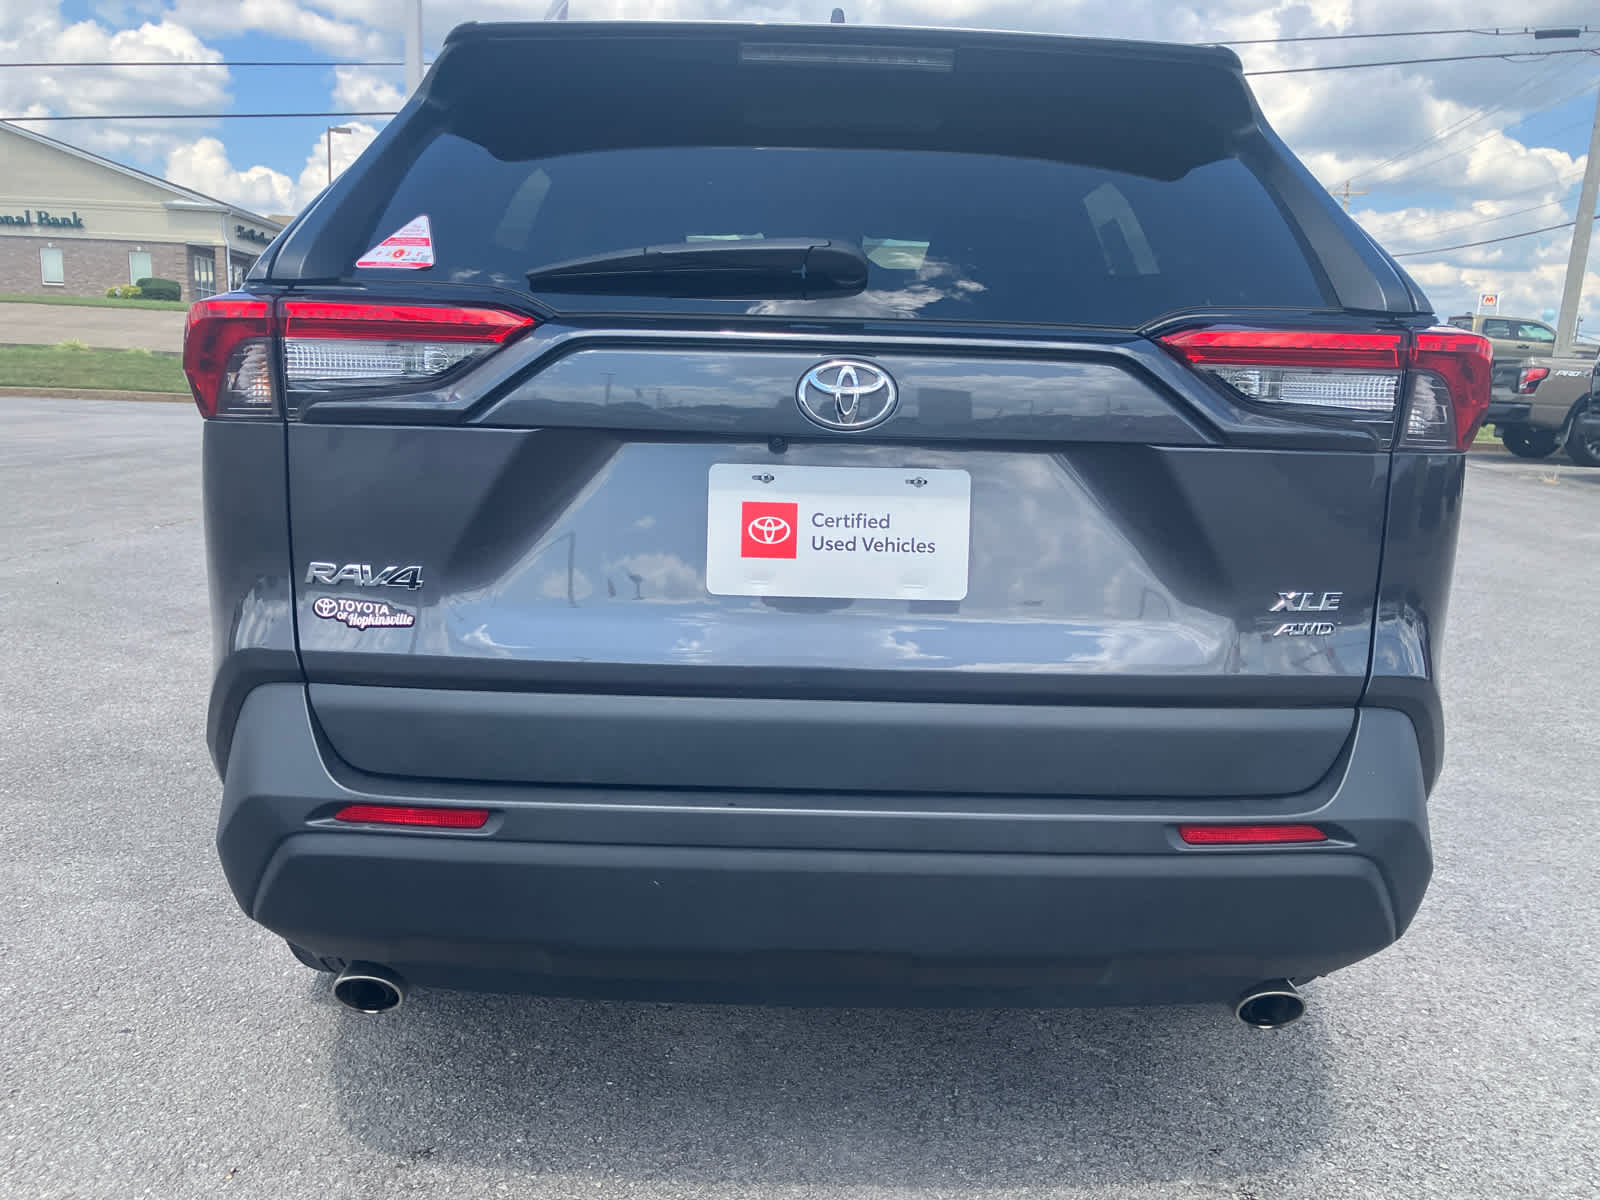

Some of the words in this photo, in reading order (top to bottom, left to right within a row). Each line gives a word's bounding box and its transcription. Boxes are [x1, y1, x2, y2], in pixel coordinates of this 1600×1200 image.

[37, 210, 84, 228] Bank
[811, 513, 890, 530] Certified
[811, 536, 857, 552] Used
[862, 538, 936, 554] Vehicles
[305, 562, 424, 590] RAV4
[338, 600, 390, 615] TOYOTA
[1269, 592, 1343, 611] XLE
[337, 612, 348, 621] OF
[349, 613, 414, 629] Hopkinsville
[1273, 622, 1335, 636] AWD
